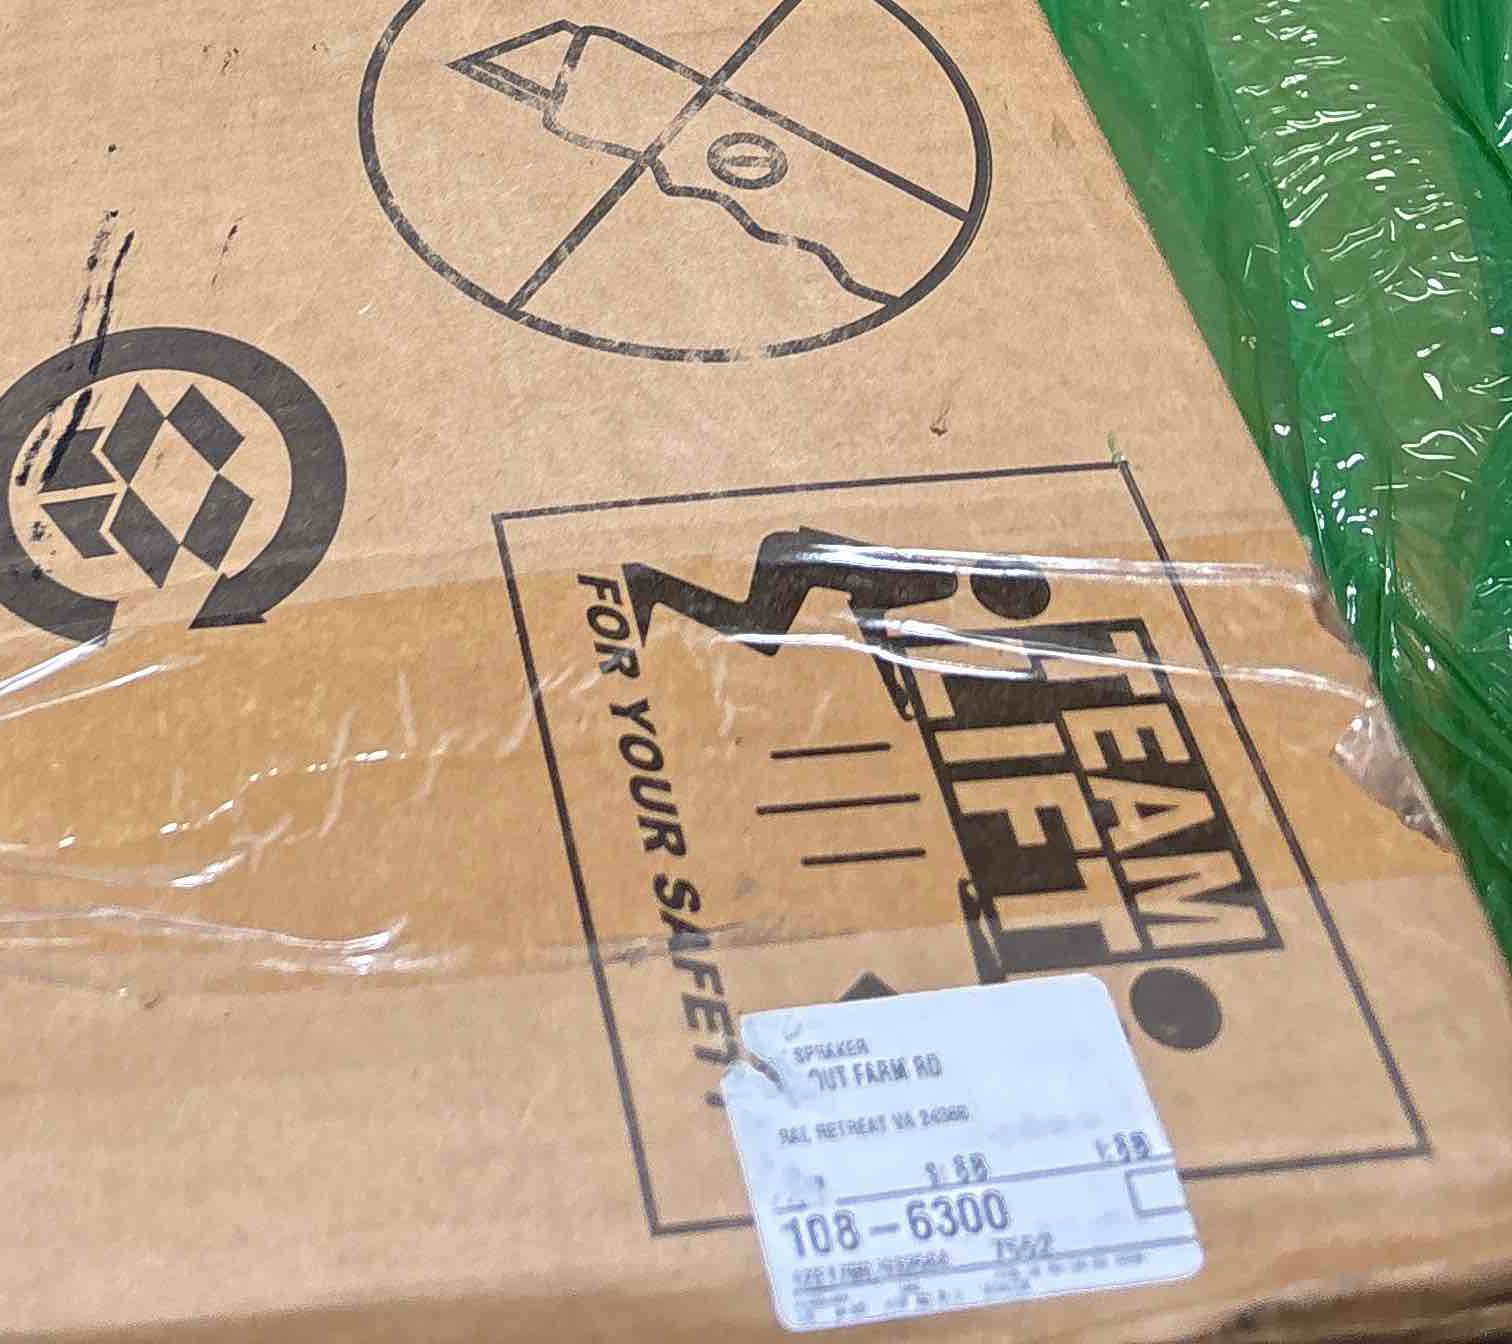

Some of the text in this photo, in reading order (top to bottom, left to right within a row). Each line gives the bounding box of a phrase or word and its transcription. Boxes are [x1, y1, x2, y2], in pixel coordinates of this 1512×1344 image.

[576, 573, 740, 1108] FOR YOUR SAFET
[901, 640, 1143, 954] LIFT
[1036, 629, 1269, 949] TEAM
[854, 1061, 909, 1085] FARM
[915, 1053, 943, 1080] RD
